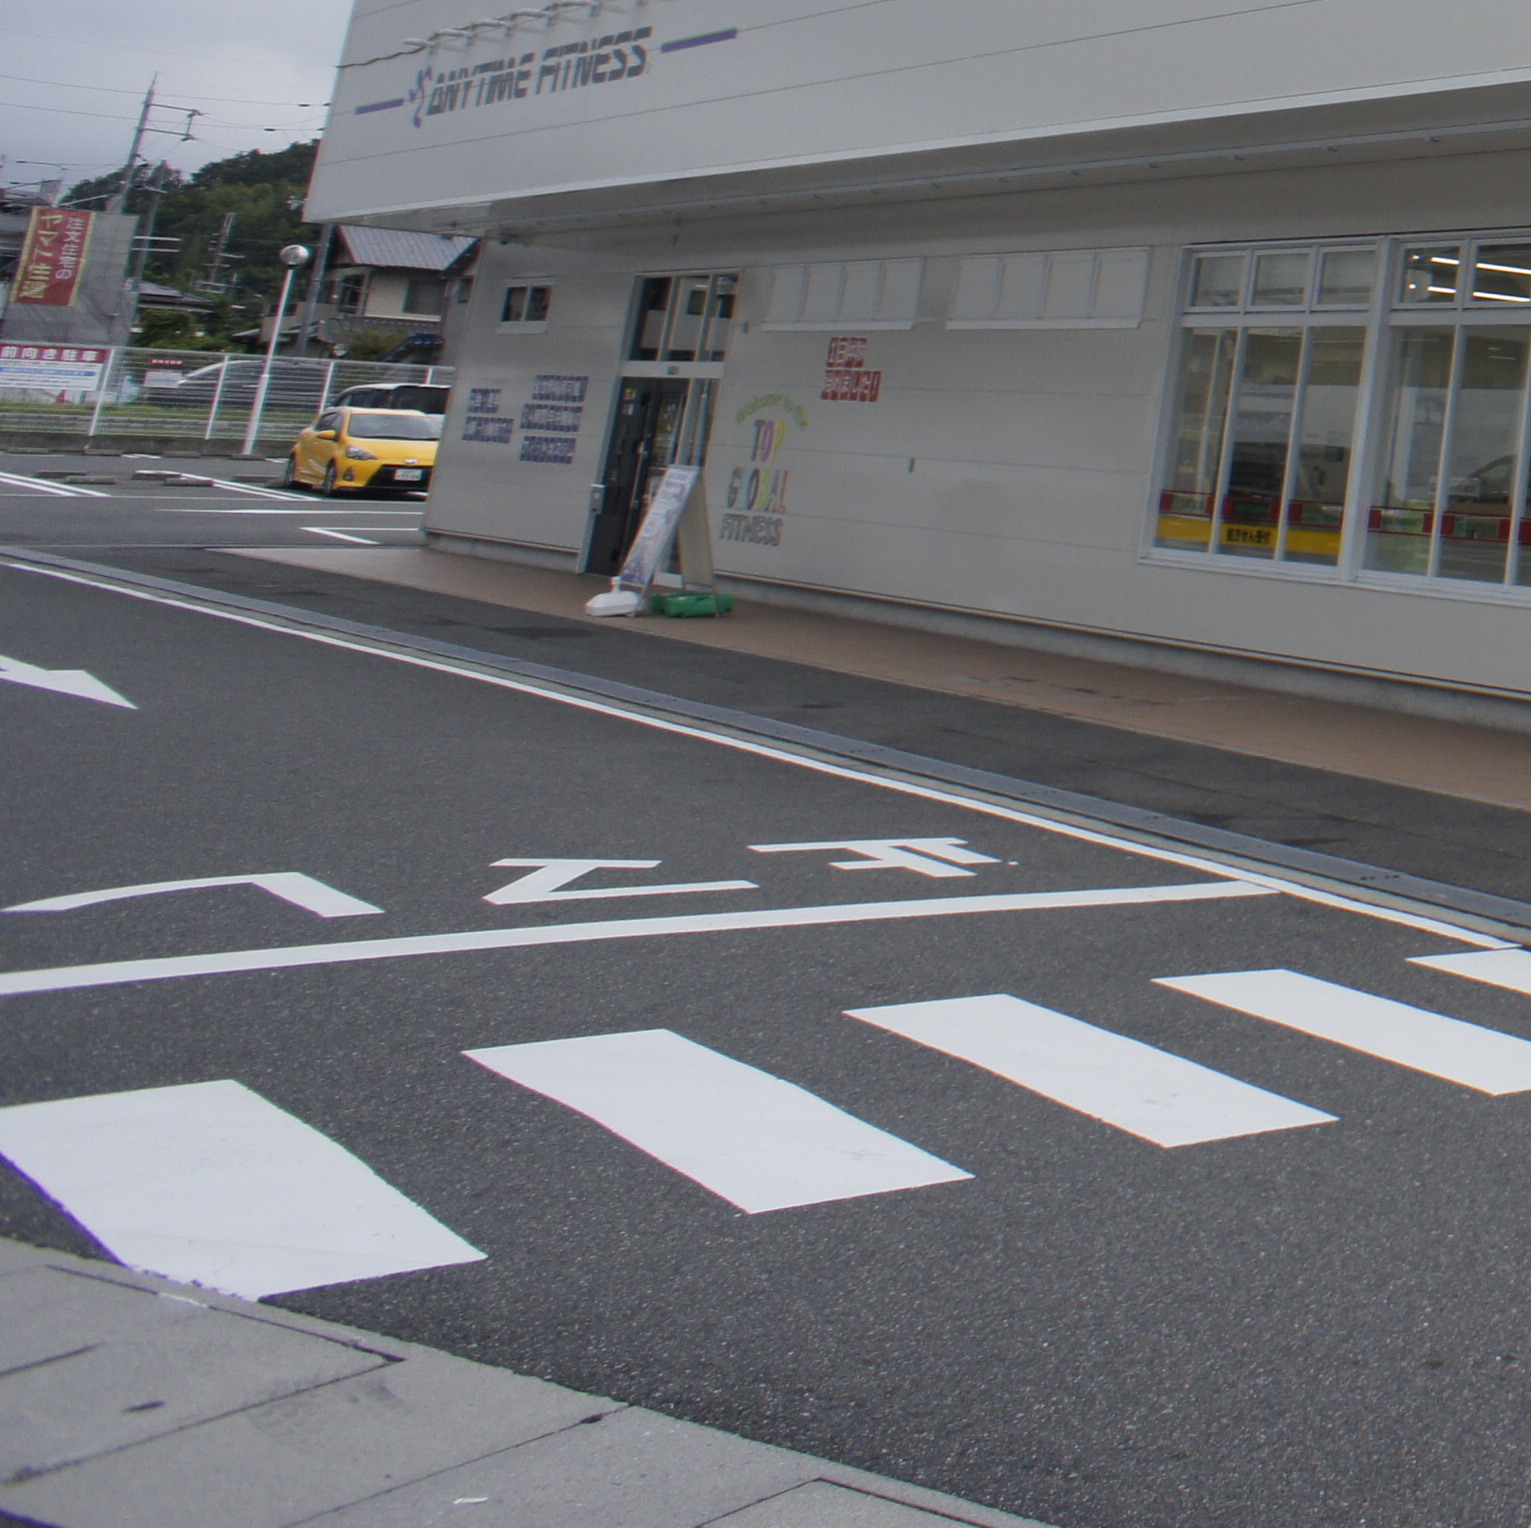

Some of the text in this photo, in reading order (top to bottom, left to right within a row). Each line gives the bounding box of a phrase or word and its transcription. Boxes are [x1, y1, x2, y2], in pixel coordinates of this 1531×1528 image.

[426, 25, 653, 117] ANYTIME FITNESS
[0, 345, 99, 362] 前向き駐車
